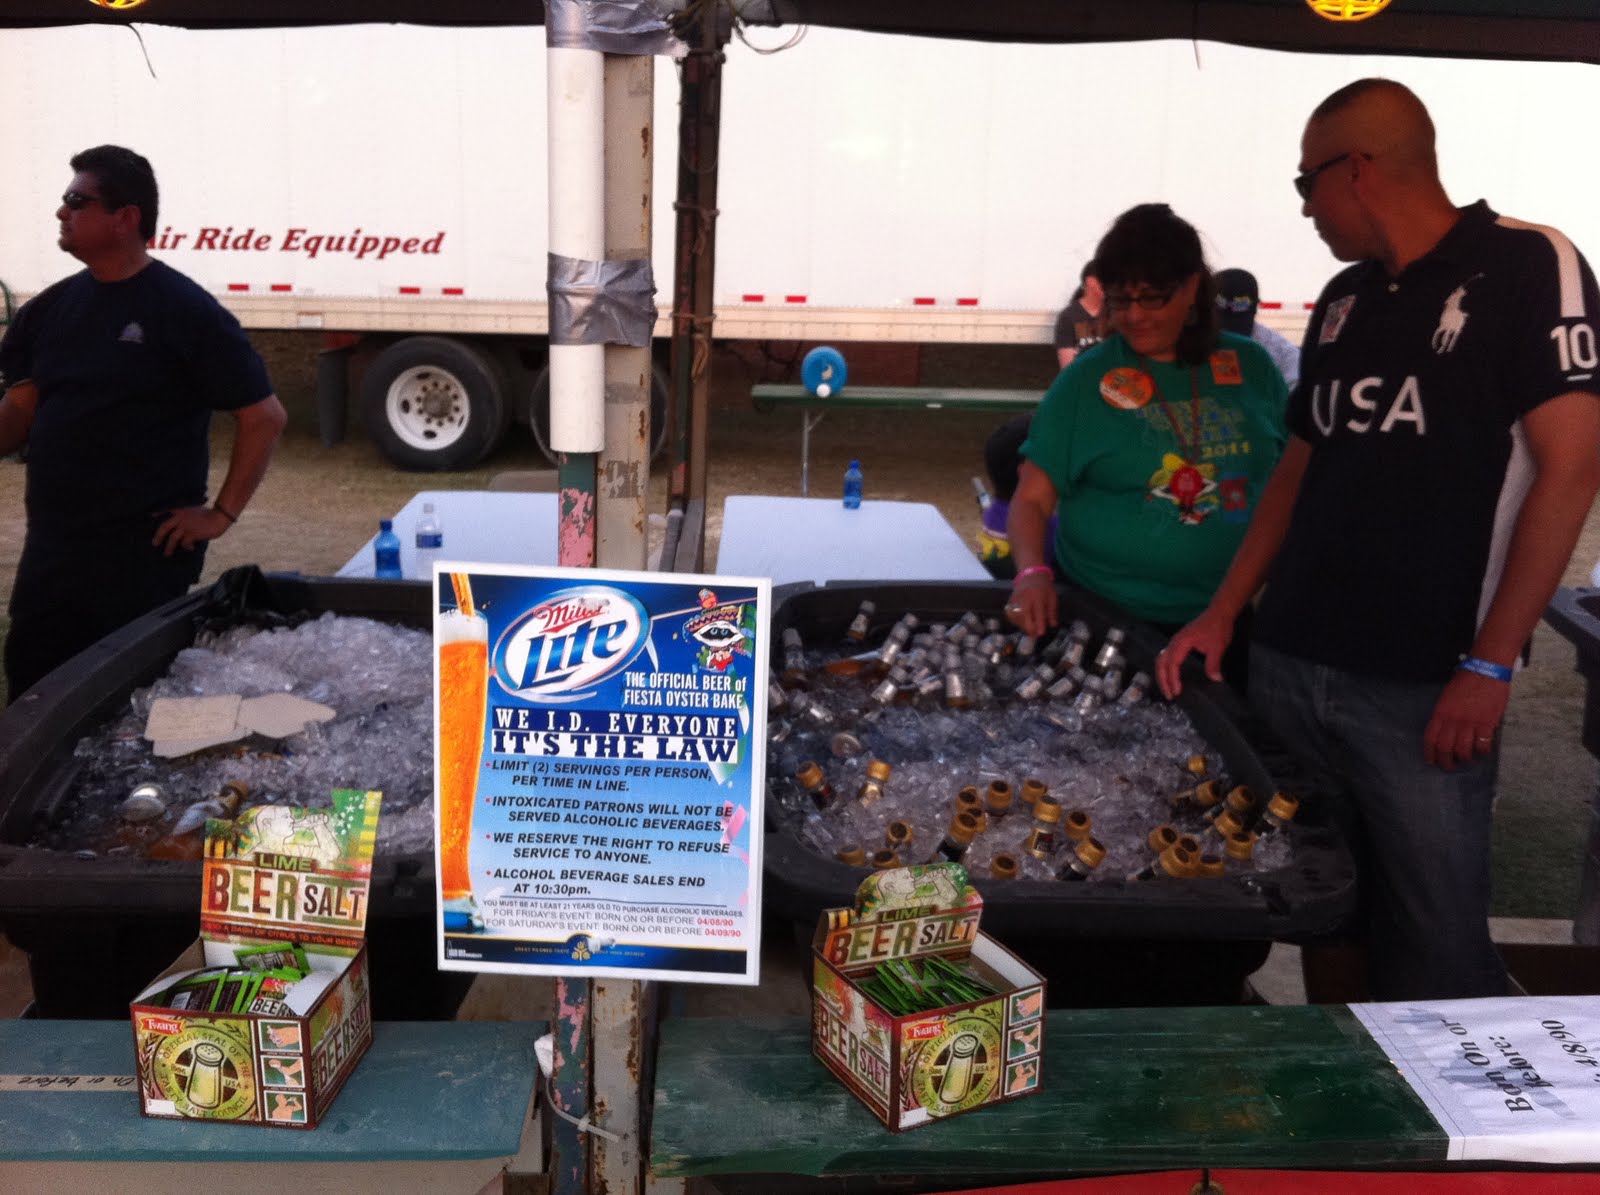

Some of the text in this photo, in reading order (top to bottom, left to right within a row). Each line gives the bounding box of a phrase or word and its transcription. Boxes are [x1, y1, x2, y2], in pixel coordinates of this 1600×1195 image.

[193, 227, 271, 251] Ride
[280, 228, 446, 260] Equipped
[1550, 323, 1599, 371] 10
[1312, 375, 1427, 436] USA
[1203, 442, 1249, 458] 2011
[517, 619, 627, 690] Lite
[625, 671, 747, 691] THE OFFICIAL BEER of
[624, 689, 743, 709] FIESTA OYSTER BAKE
[495, 708, 736, 737] WE I.D. EVERYONE
[492, 730, 736, 762] IT'S THE LAW
[492, 760, 528, 771] LIMIT
[532, 762, 549, 773] (2)
[554, 763, 621, 776] SERVINGS
[624, 766, 650, 777] PER
[512, 776, 630, 792] PER TIME IN LINE.
[492, 797, 733, 817] INTOXICATED PATRONS WILL NOT BE
[508, 811, 725, 832] SERVED ALCOHOLIC BEVERAGES.
[493, 833, 730, 854] WE RESERVE THE RIGHT TO REFUSE
[259, 853, 313, 871] LIME
[513, 848, 652, 864] SERVICE TO ANYONE.
[493, 869, 705, 887] ALCOHOL BEVERAGE SALES END
[208, 868, 365, 920] BEER SALT
[513, 884, 591, 897] AT 10:30pm.
[516, 910, 556, 918] FRIDAY'S
[595, 912, 620, 921] BORN
[623, 914, 637, 923] ON
[640, 915, 654, 923] OR
[657, 916, 694, 924] BEFORE
[697, 918, 733, 926] 04/08/90
[622, 905, 659, 913] PURCHASE
[881, 907, 931, 922] LIME
[509, 920, 565, 929] SATURDAY'S
[603, 923, 629, 932] BORN
[632, 925, 645, 933] ON
[664, 927, 702, 935] BEFORE
[705, 929, 741, 937] 04/09/90
[828, 918, 977, 964] BEER SALT
[148, 1019, 178, 1034] Twang
[1441, 1018, 1468, 1036] or
[163, 1033, 200, 1059] OFFICIAL
[202, 1033, 226, 1046] SEAL
[229, 1045, 241, 1058] OF
[820, 1002, 858, 1074] BEER
[1541, 1019, 1599, 1067] 4/8/90
[1460, 1040, 1491, 1066] On
[975, 1064, 989, 1072] USA
[18, 1076, 80, 1088] before
[113, 1077, 136, 1086] On
[224, 1079, 241, 1088] USA
